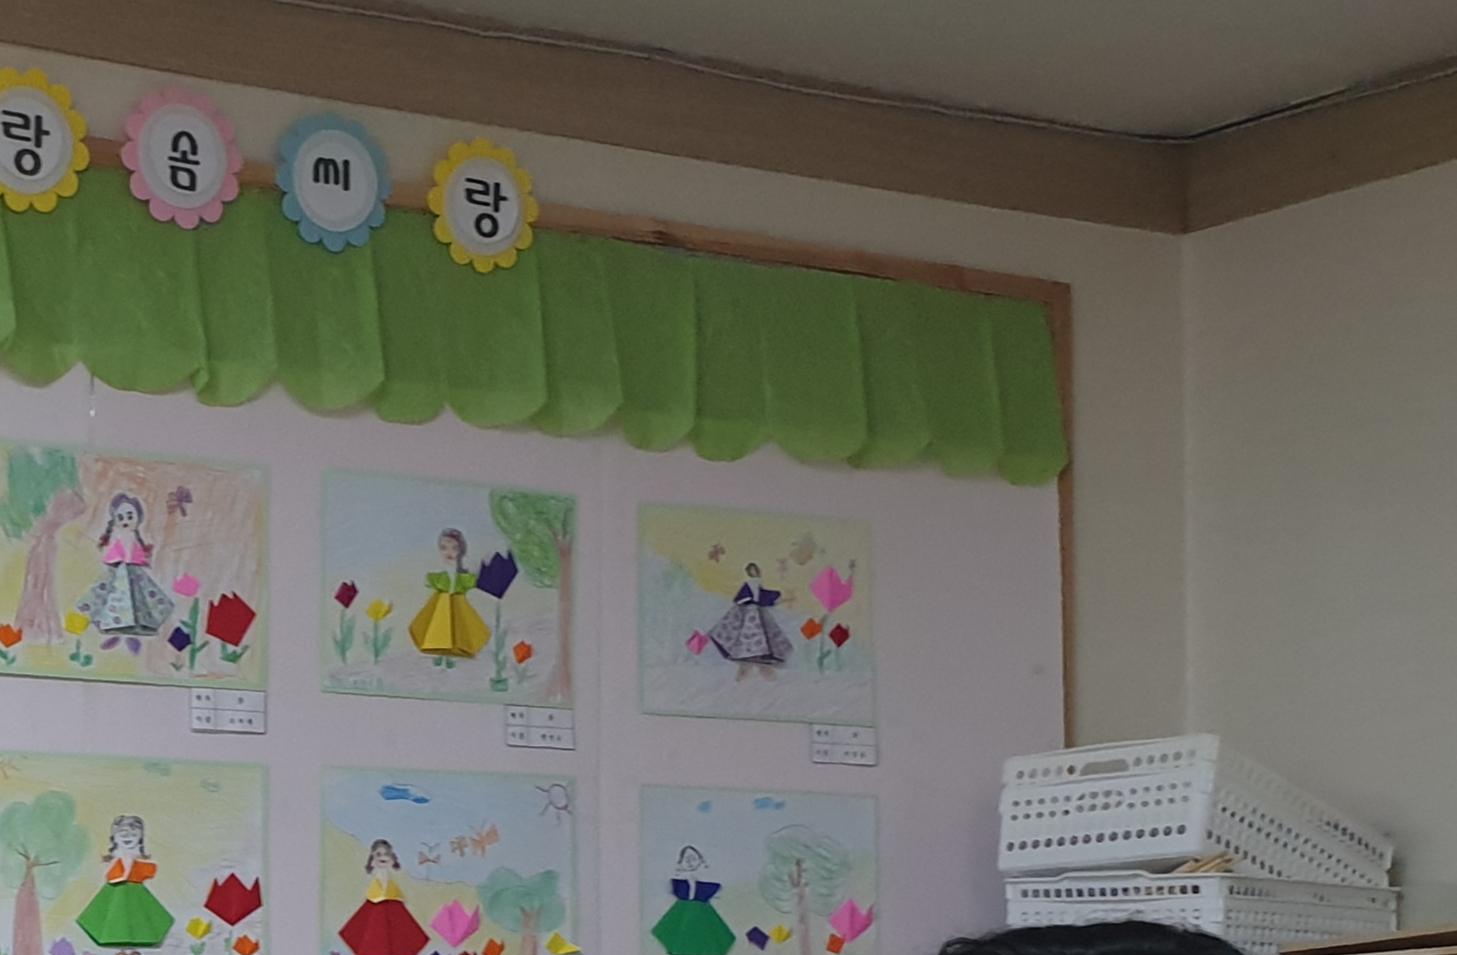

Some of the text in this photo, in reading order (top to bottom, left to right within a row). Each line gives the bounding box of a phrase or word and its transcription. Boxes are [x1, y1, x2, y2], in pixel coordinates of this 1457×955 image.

[0, 109, 51, 177] 랑
[166, 130, 201, 193] 솜
[311, 156, 351, 192] 씨
[463, 176, 509, 239] 랑
